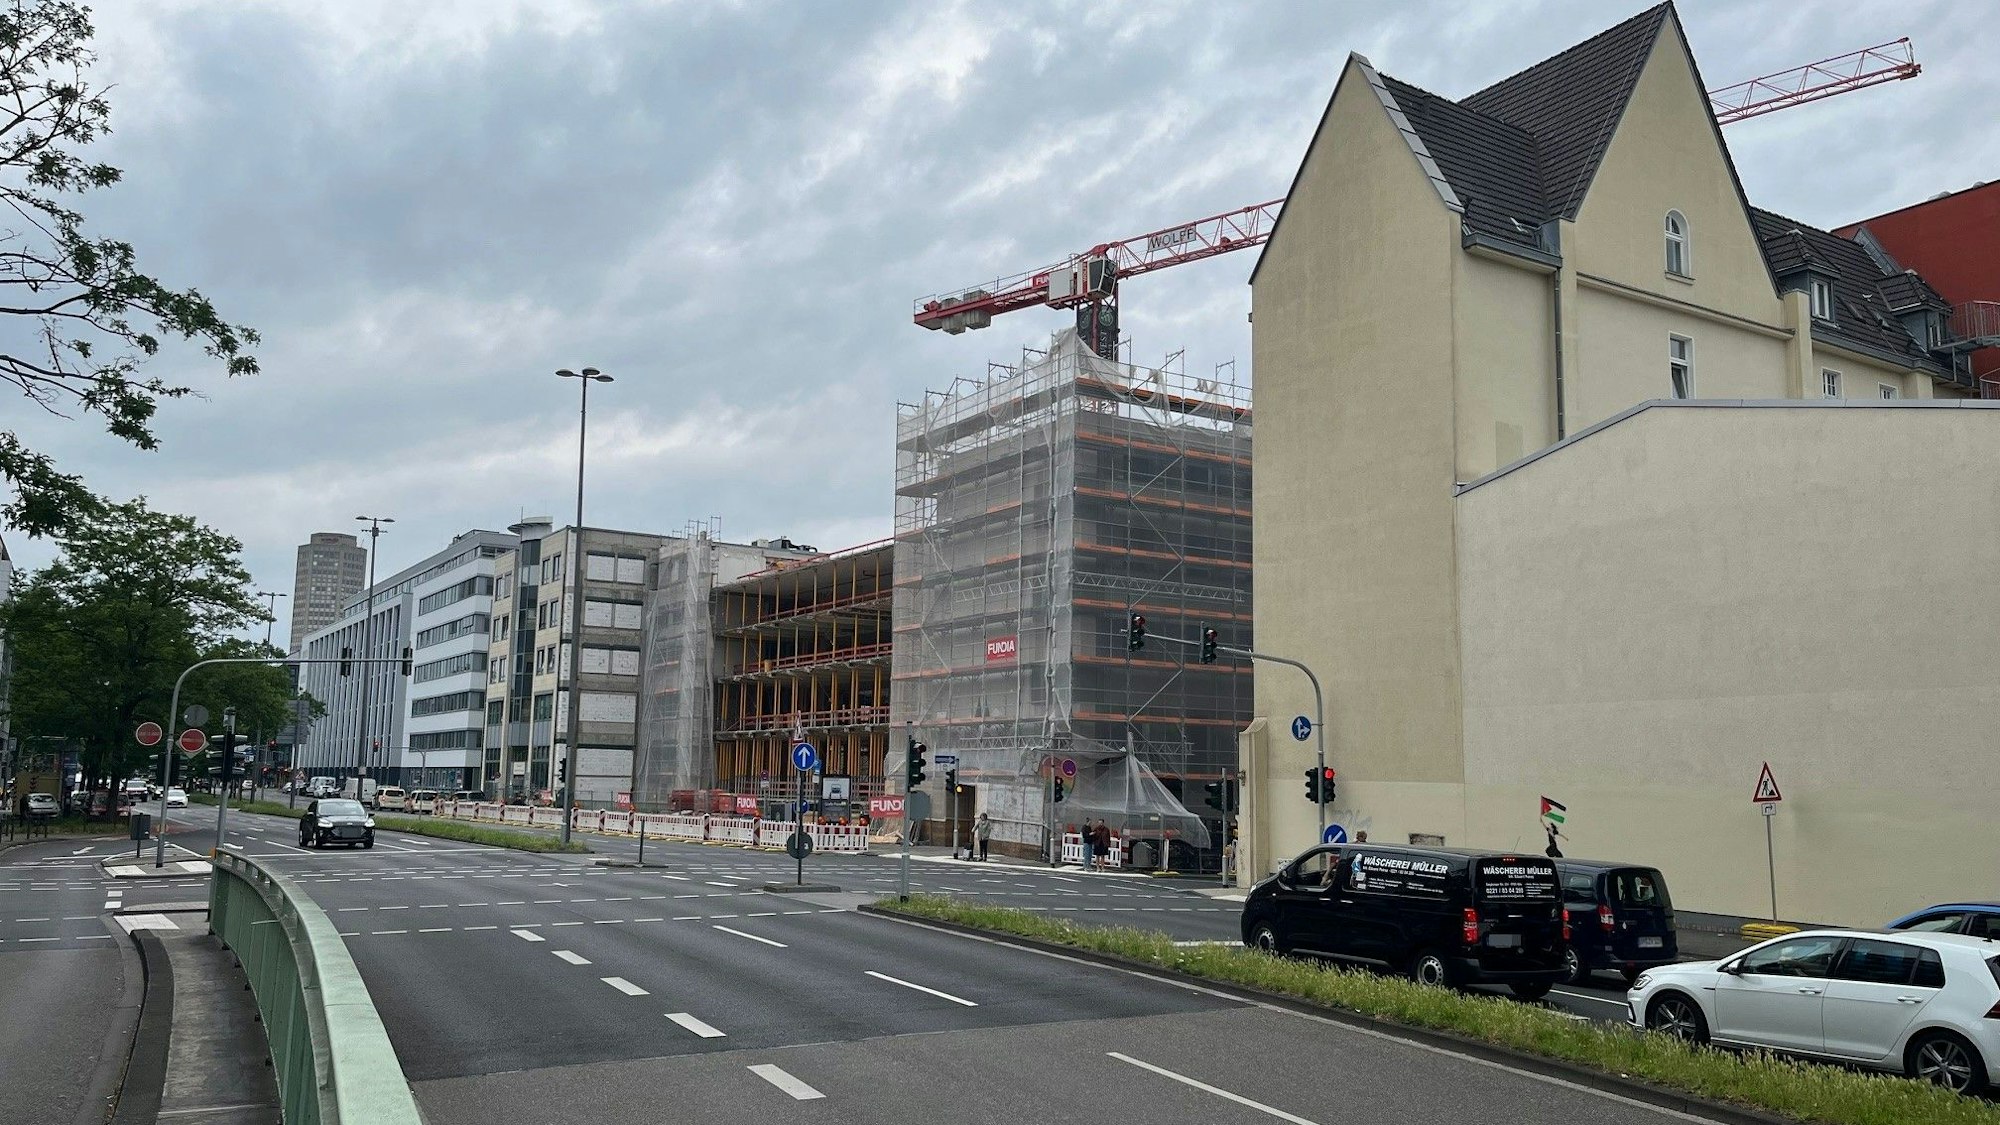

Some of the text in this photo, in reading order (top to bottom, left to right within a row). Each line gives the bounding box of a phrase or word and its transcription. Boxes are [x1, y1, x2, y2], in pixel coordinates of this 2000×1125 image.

[1150, 228, 1194, 249] WOLFF
[987, 640, 1015, 655] FUNDIA
[1363, 855, 1411, 870] WÄSCHEREI
[1411, 861, 1449, 874] MÜLLER
[1483, 865, 1553, 875] WÄSCHEREI MÜLLER
